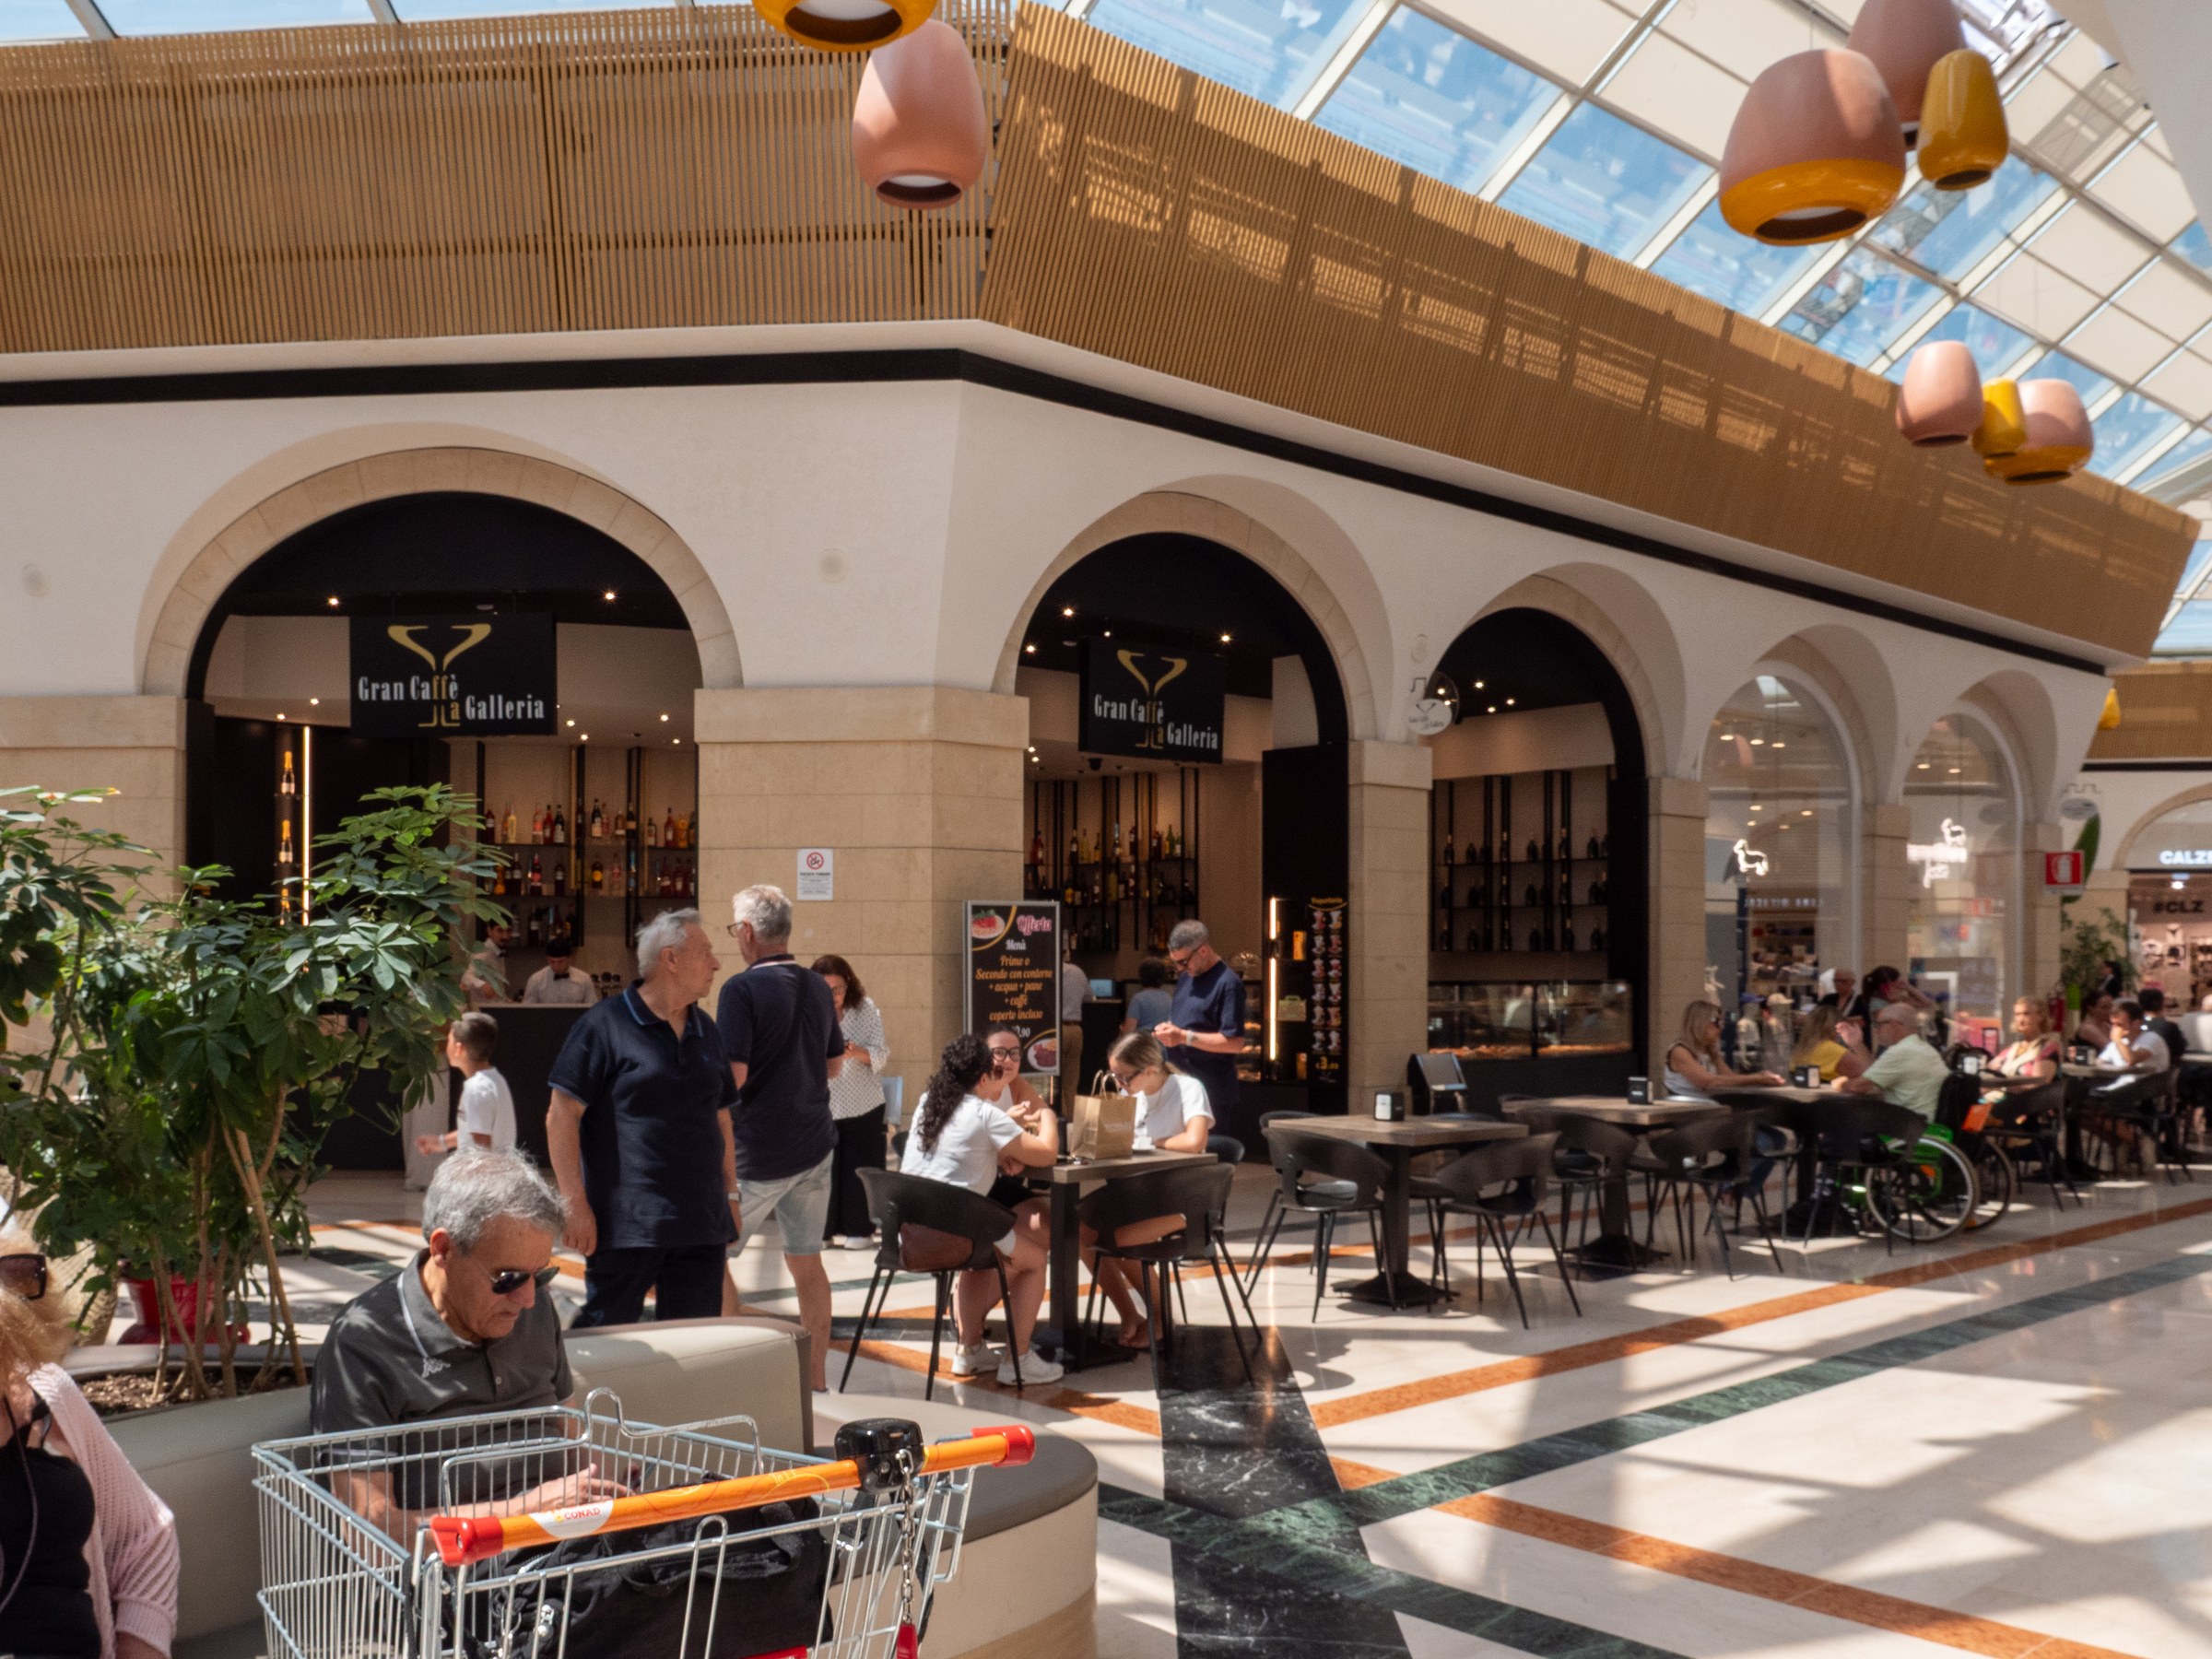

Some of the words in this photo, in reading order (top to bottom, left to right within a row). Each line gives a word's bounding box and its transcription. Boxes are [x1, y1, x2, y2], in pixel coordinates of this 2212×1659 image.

[359, 677, 405, 700] Gran
[410, 674, 459, 700] Caffè
[465, 695, 545, 720] Galleria
[1094, 694, 1127, 720] Gran
[1130, 698, 1164, 724] Caffè
[1167, 723, 1218, 749] Galleria
[2159, 850, 2212, 865] CALZ
[1017, 914, 1052, 935] Offerta
[1000, 954, 1023, 966] Primo
[976, 968, 1007, 980] Secondo
[1009, 970, 1022, 979] con
[1023, 969, 1053, 979] contorno
[994, 982, 1018, 994] acqua
[1024, 982, 1043, 994] pane
[989, 1010, 1016, 1023] coperto
[1018, 1008, 1043, 1020] incluso
[564, 1507, 601, 1520] CONAD
